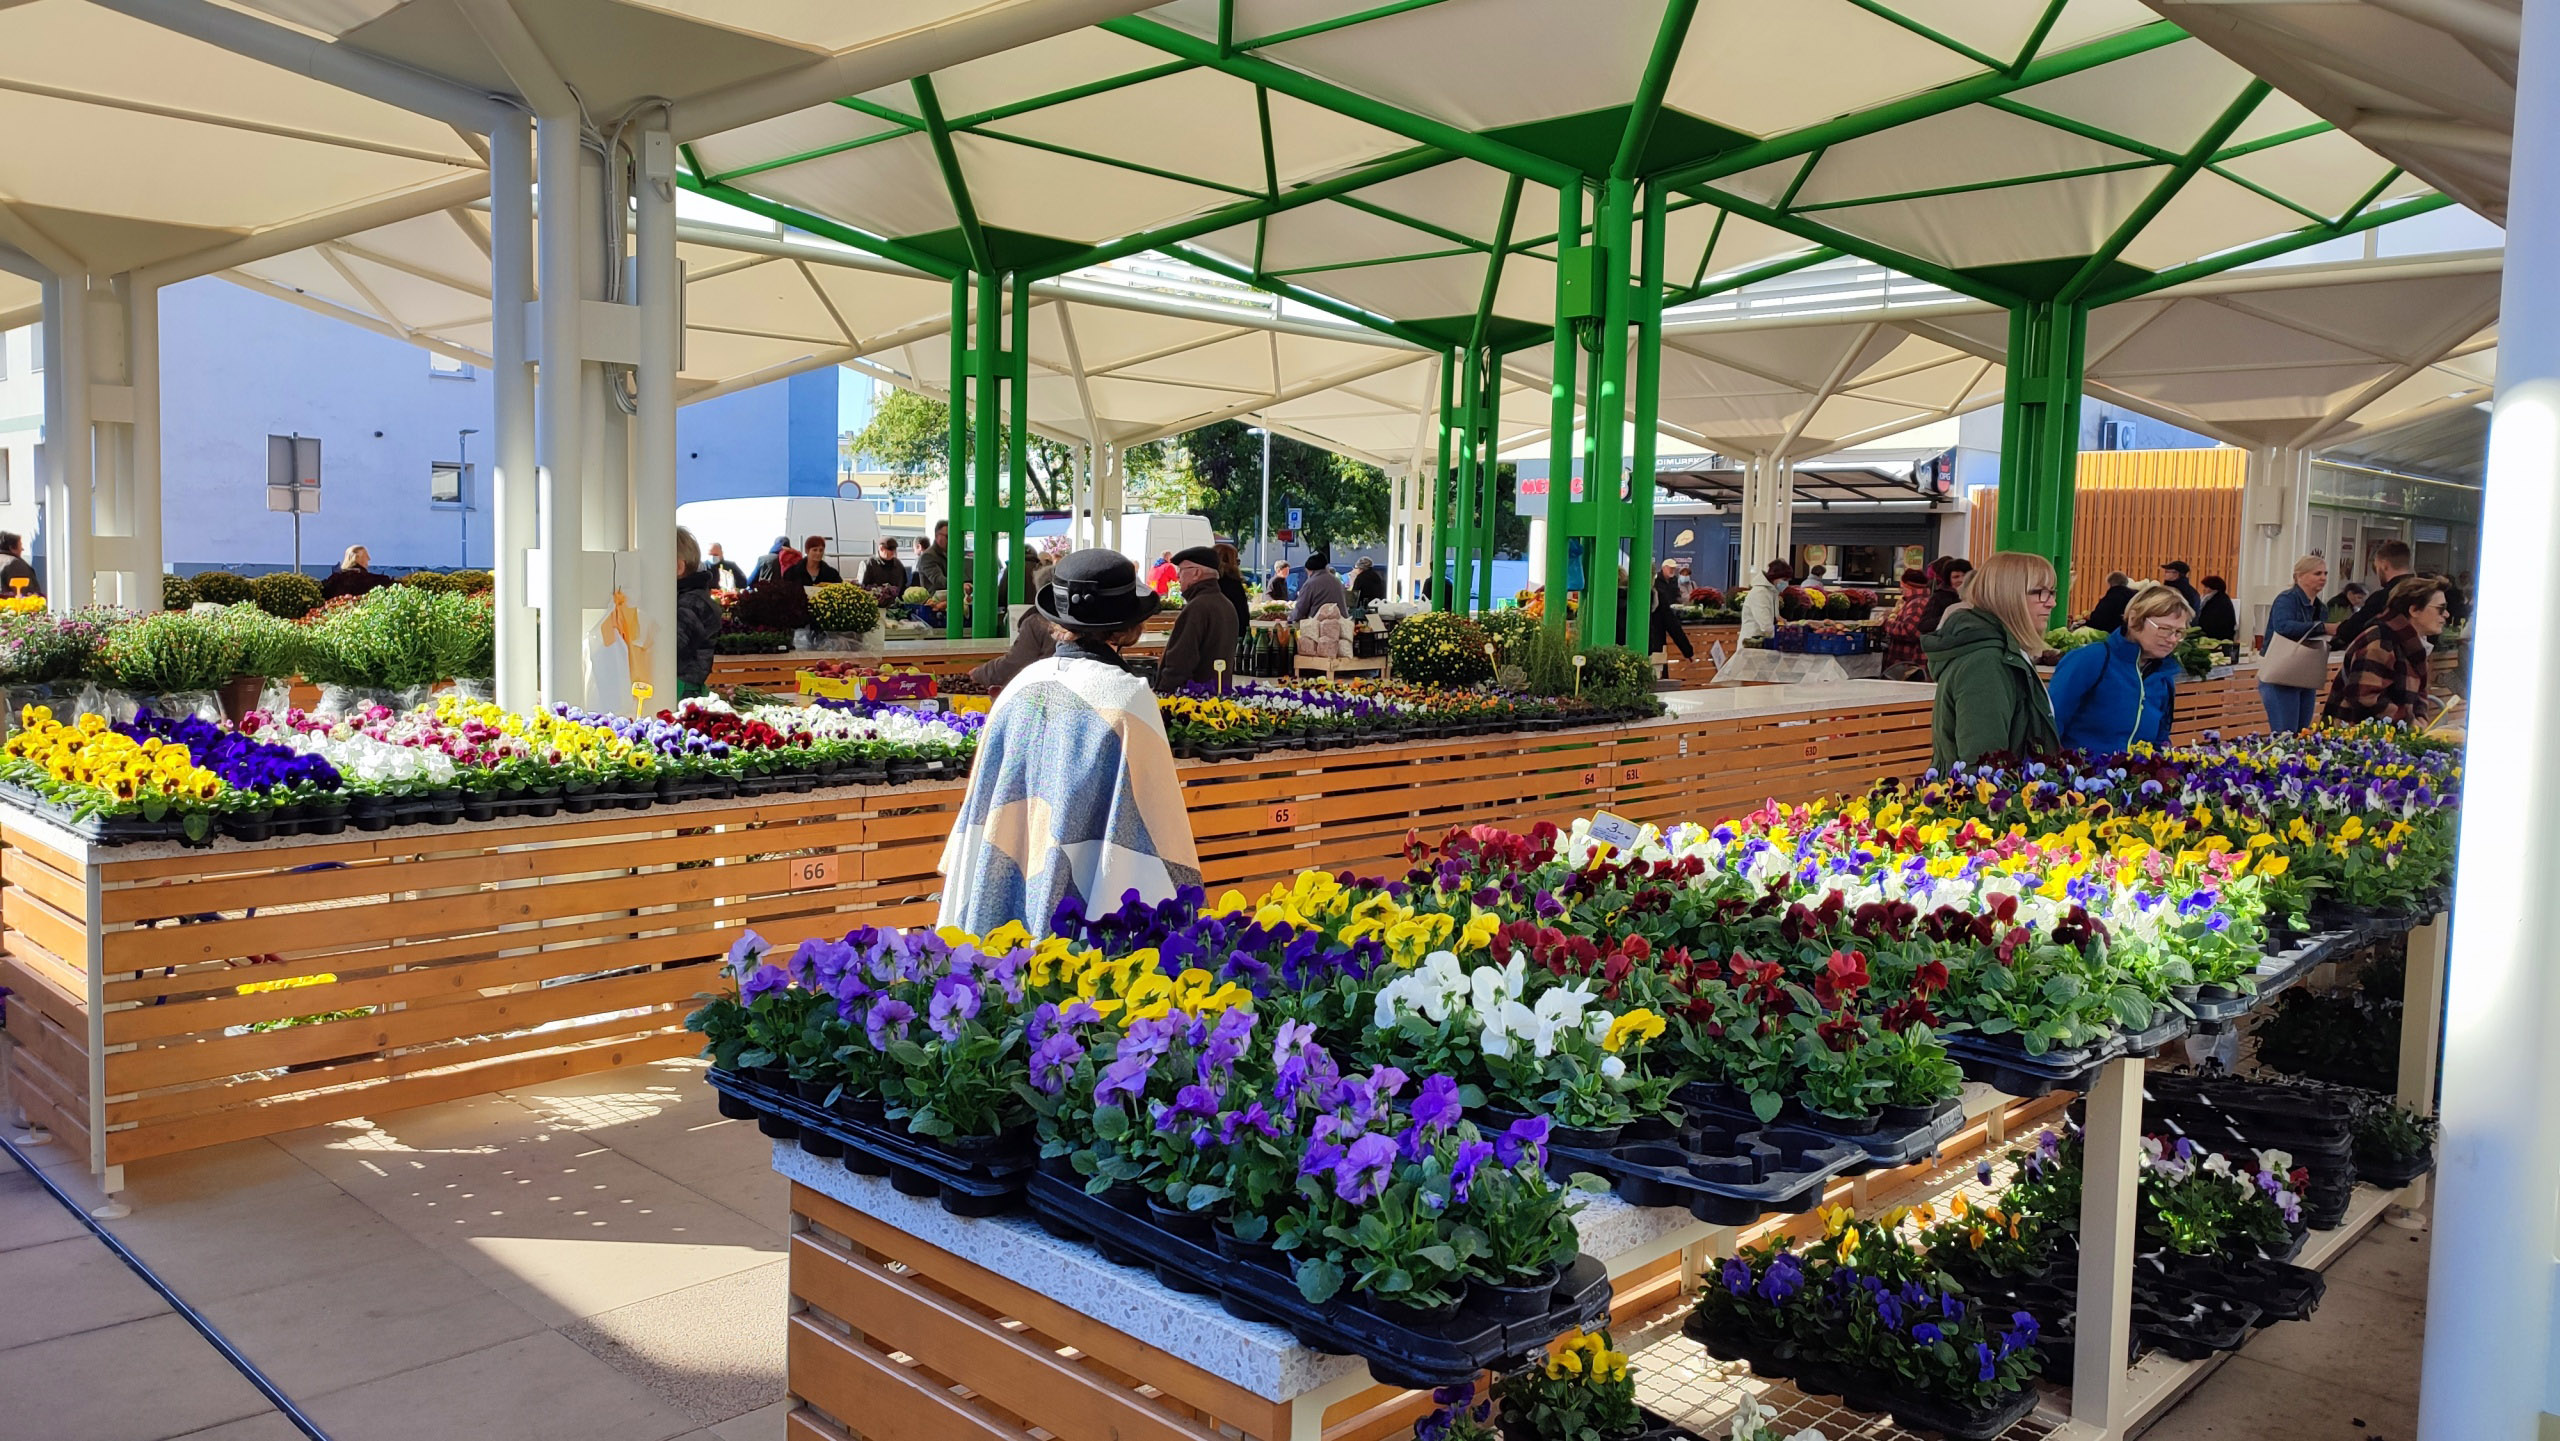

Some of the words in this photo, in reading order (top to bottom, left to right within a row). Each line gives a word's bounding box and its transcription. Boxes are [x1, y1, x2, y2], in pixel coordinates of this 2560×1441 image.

[1805, 745, 1818, 757] 63D
[1584, 773, 1595, 785] 64
[1626, 768, 1640, 781] 63L
[1275, 808, 1289, 823] 65
[803, 862, 825, 881] 66
